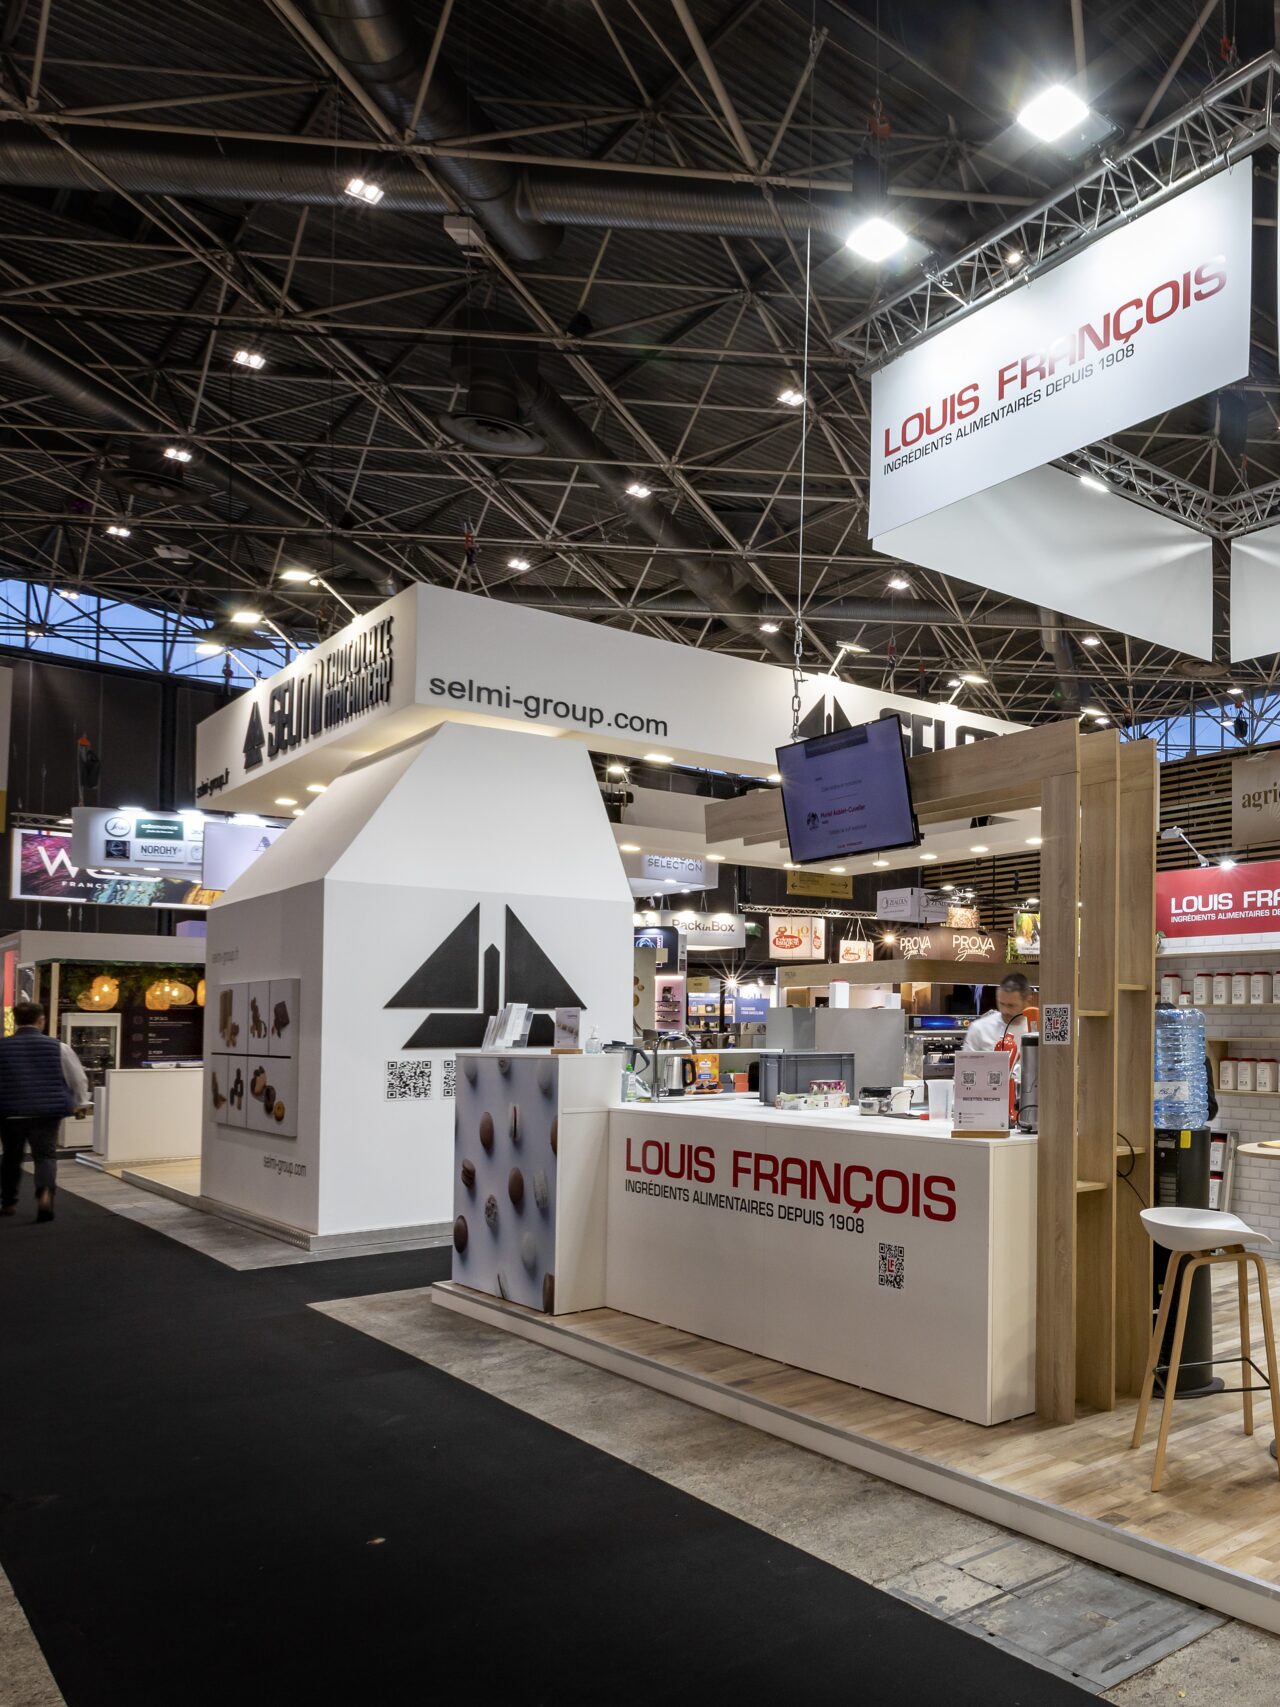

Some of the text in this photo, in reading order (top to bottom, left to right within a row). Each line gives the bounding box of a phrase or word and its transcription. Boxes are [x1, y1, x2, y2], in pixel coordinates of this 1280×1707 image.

[884, 255, 1227, 457] LOUIS FRANÇOIS
[884, 344, 1135, 476] INGRÉDIENTS ALIMENTAIRES DEPUIS 1908
[326, 615, 393, 690] CHOCOLATE
[324, 656, 393, 729] MACHINERY
[429, 677, 669, 737] selmi-group.com
[140, 845, 178, 856] NOROHY
[647, 858, 702, 873] SELECTION
[61, 880, 109, 890] FRANCE
[1171, 893, 1233, 914] LOUIS
[1171, 912, 1216, 923] INGRÉDIENTS
[1217, 909, 1270, 920] ALIMENTAIRES
[900, 936, 931, 951] PROVA
[952, 935, 996, 951] PROVA
[626, 1137, 956, 1222] LOUIS FRANÇOIS
[625, 1178, 865, 1234] INGRÉDIENTS ALIMENTAIRES DEPUIS 1908
